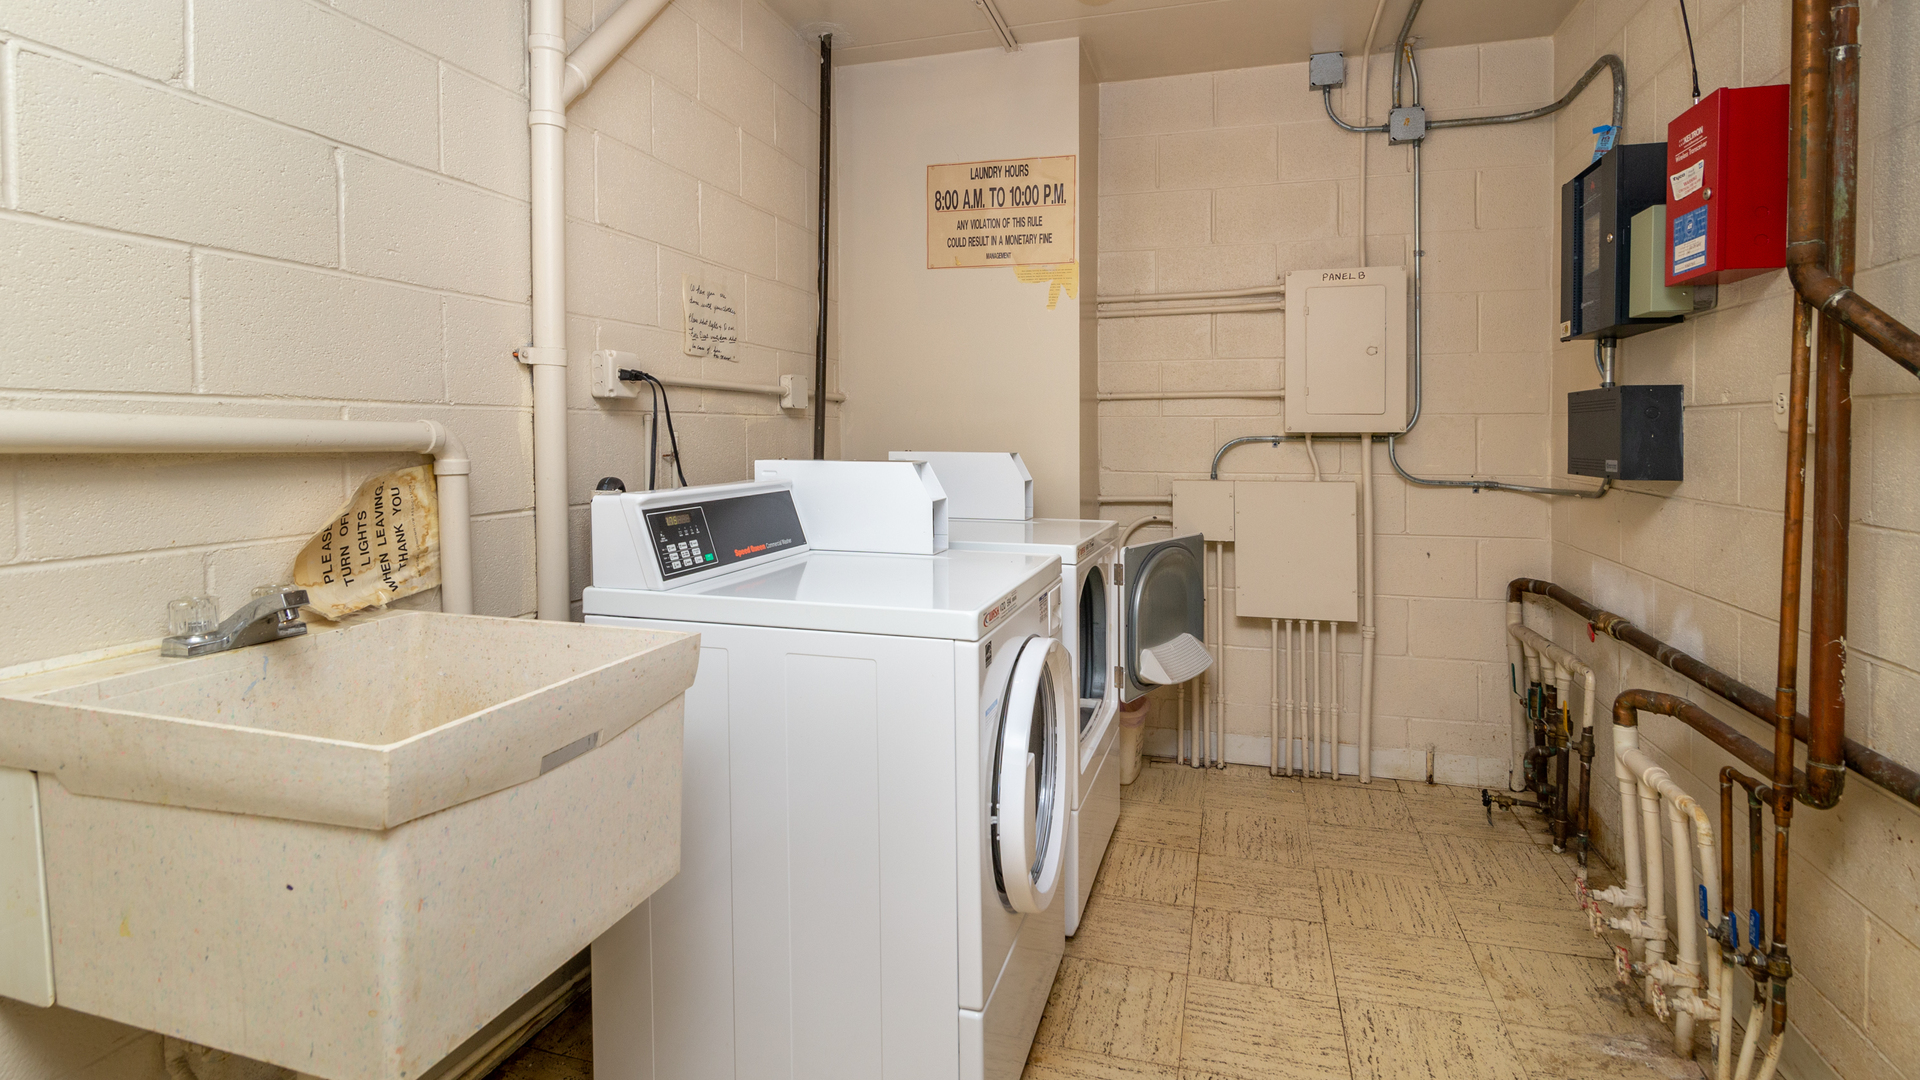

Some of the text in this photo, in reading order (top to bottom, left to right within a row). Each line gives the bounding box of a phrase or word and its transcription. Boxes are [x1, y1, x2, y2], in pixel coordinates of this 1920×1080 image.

[1682, 126, 1703, 142] KELTRON
[1675, 152, 1688, 163] Wireless
[1688, 141, 1707, 155] Transceiver
[971, 164, 1029, 180] LAUNDRY HOURS
[935, 183, 1066, 210] 8:00 A.M. TO 10:00 P.M.
[957, 216, 1042, 230] ANY VIOLATION OF THIS RULE
[947, 233, 1052, 248] COULD RESULT IN A MONETARY FINE
[1322, 272, 1366, 281] PANEL B
[357, 510, 370, 566] LIGHTS
[375, 481, 398, 592] WHEN LEAVING.
[391, 487, 409, 571] THANK YOU
[322, 523, 334, 584] PLEASE
[734, 546, 751, 557] Speed
[750, 544, 766, 553] Queen
[766, 540, 782, 548] Commercial
[339, 546, 354, 587] TURN
